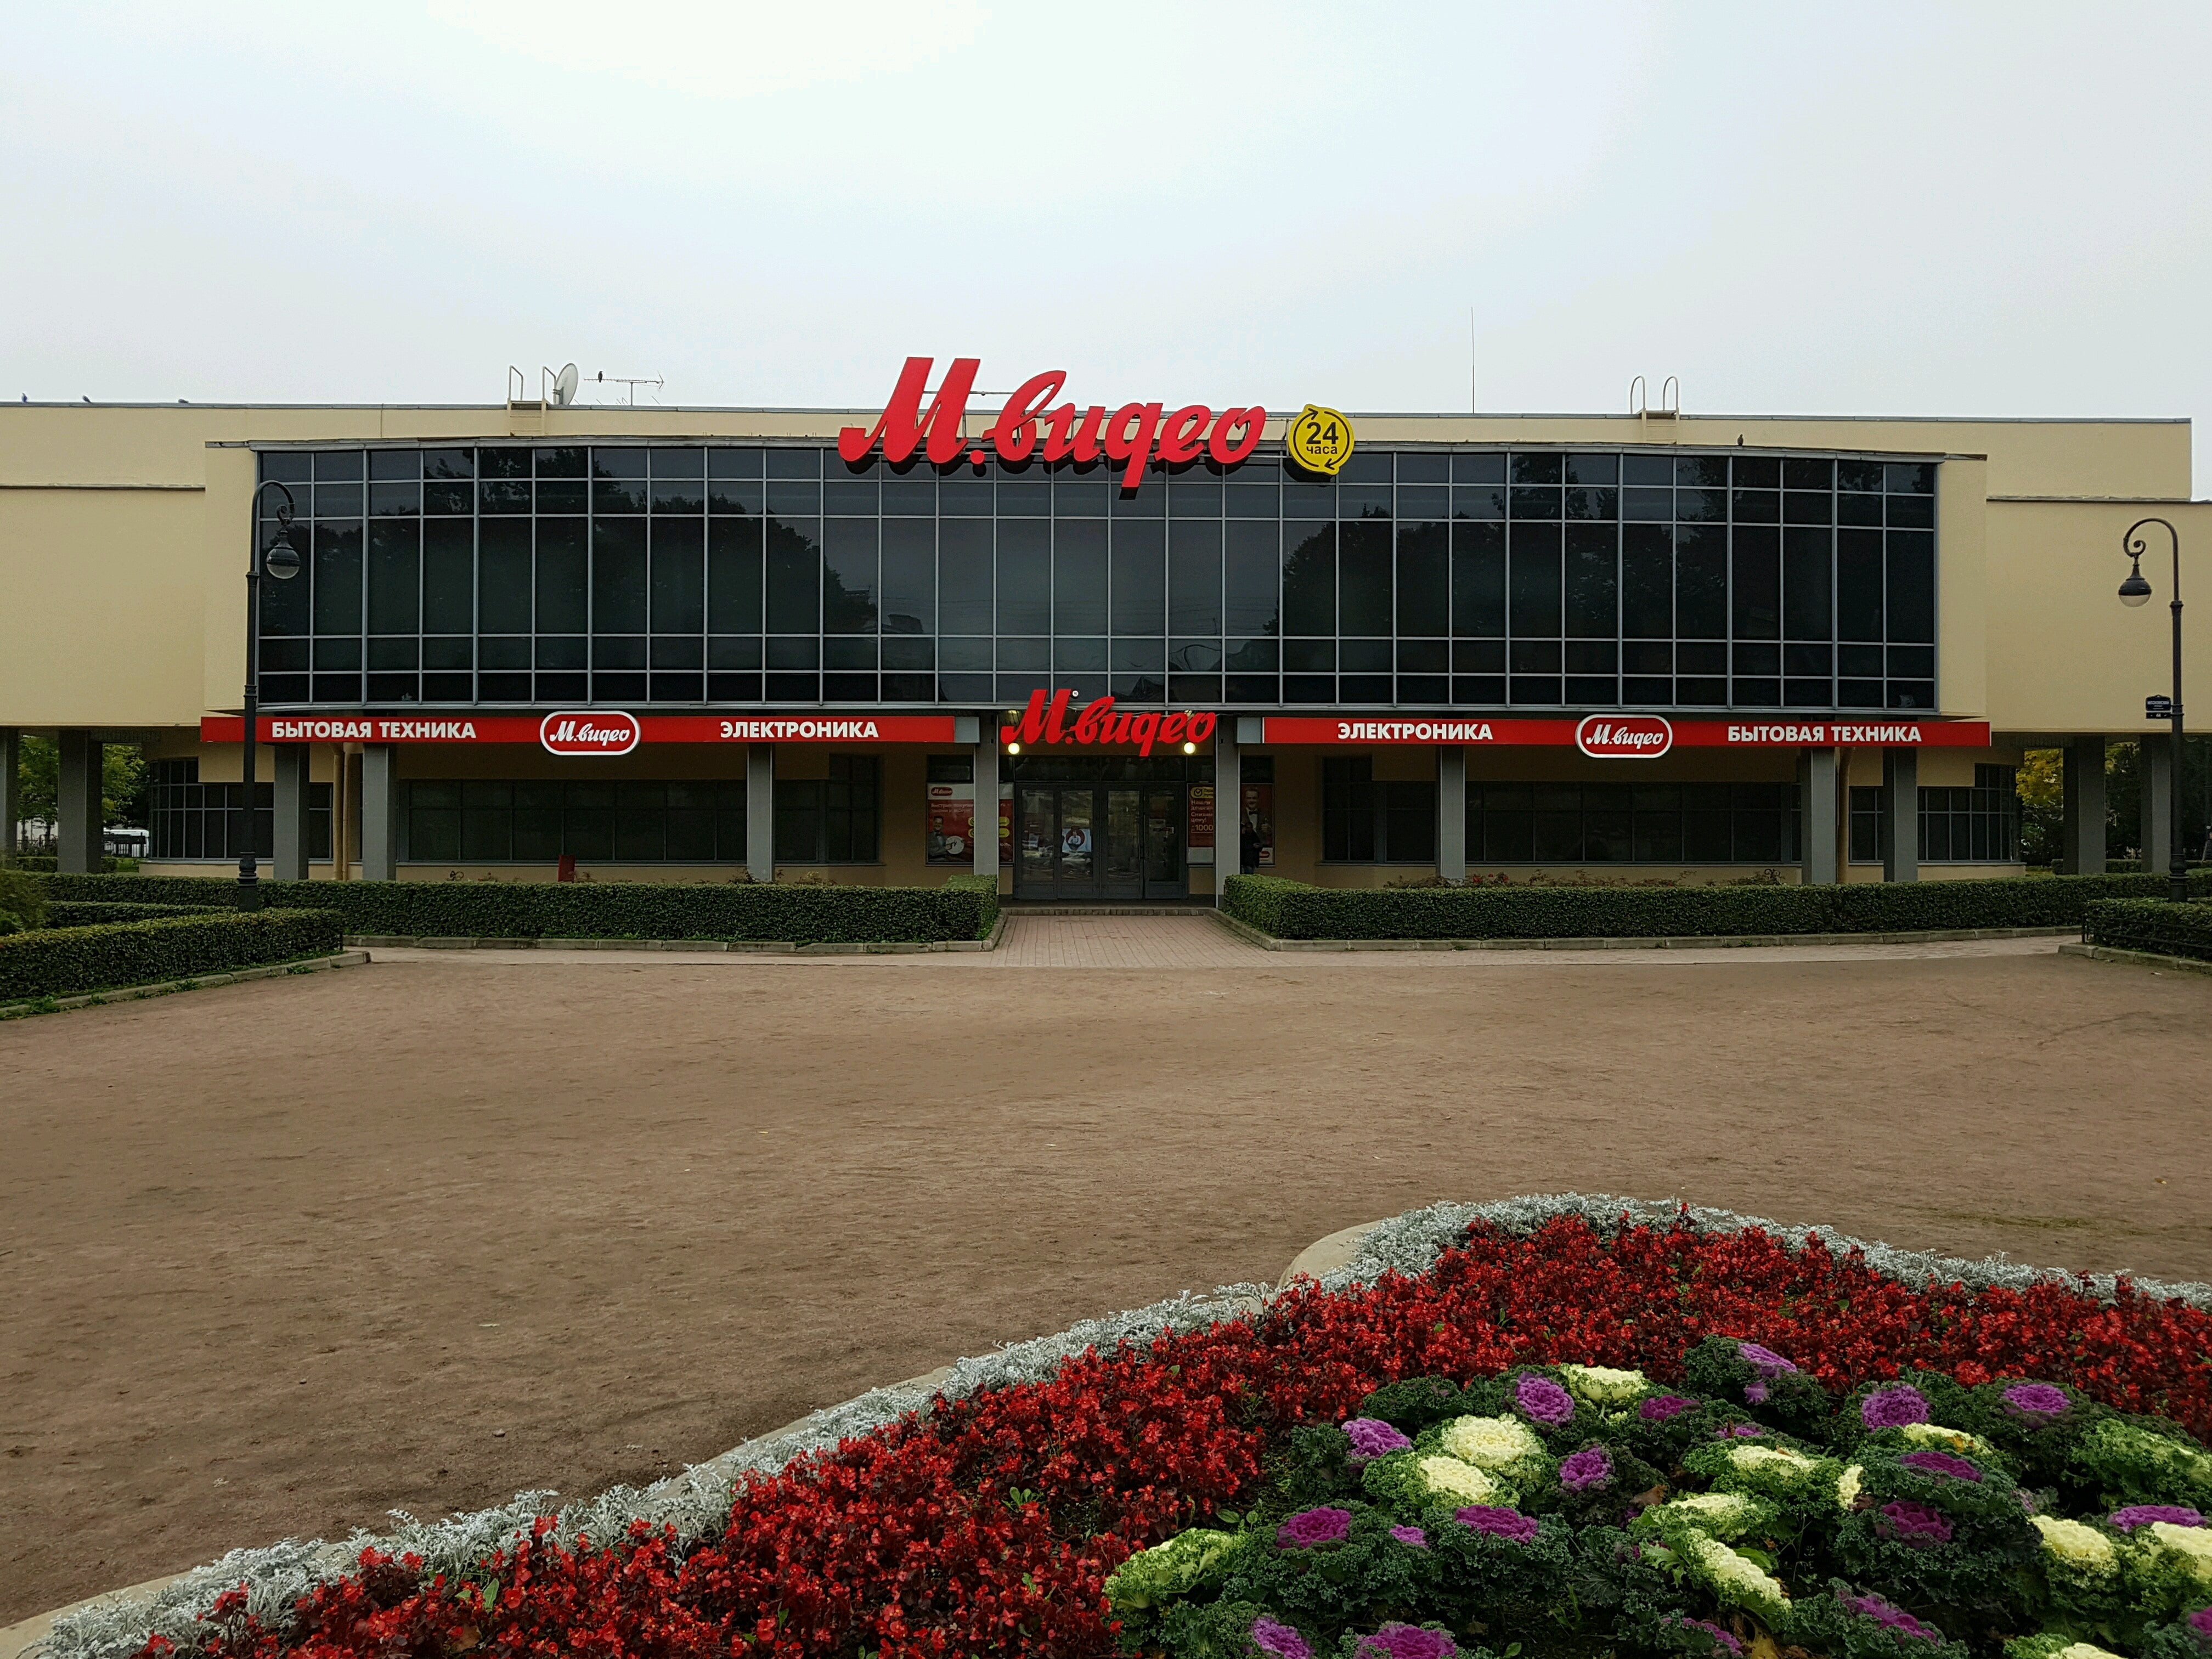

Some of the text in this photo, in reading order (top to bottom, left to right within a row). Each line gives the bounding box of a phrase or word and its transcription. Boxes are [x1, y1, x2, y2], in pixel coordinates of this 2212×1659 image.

[838, 357, 1266, 488] М.видео
[1306, 422, 1339, 444] 24
[1306, 446, 1338, 454] часа
[272, 721, 476, 739] БЫТОВАЯ ТЕХНИКА
[549, 720, 630, 746] М.видео
[720, 721, 879, 738] ЭЛЕКТРОНИКА
[1000, 689, 1216, 757] М.видео
[1338, 723, 1493, 740] ЭЛЕКТРОНИКА
[1585, 724, 1664, 749] М.видео
[1728, 726, 1922, 742] БЫТОВАЯ ТЕХНИКА
